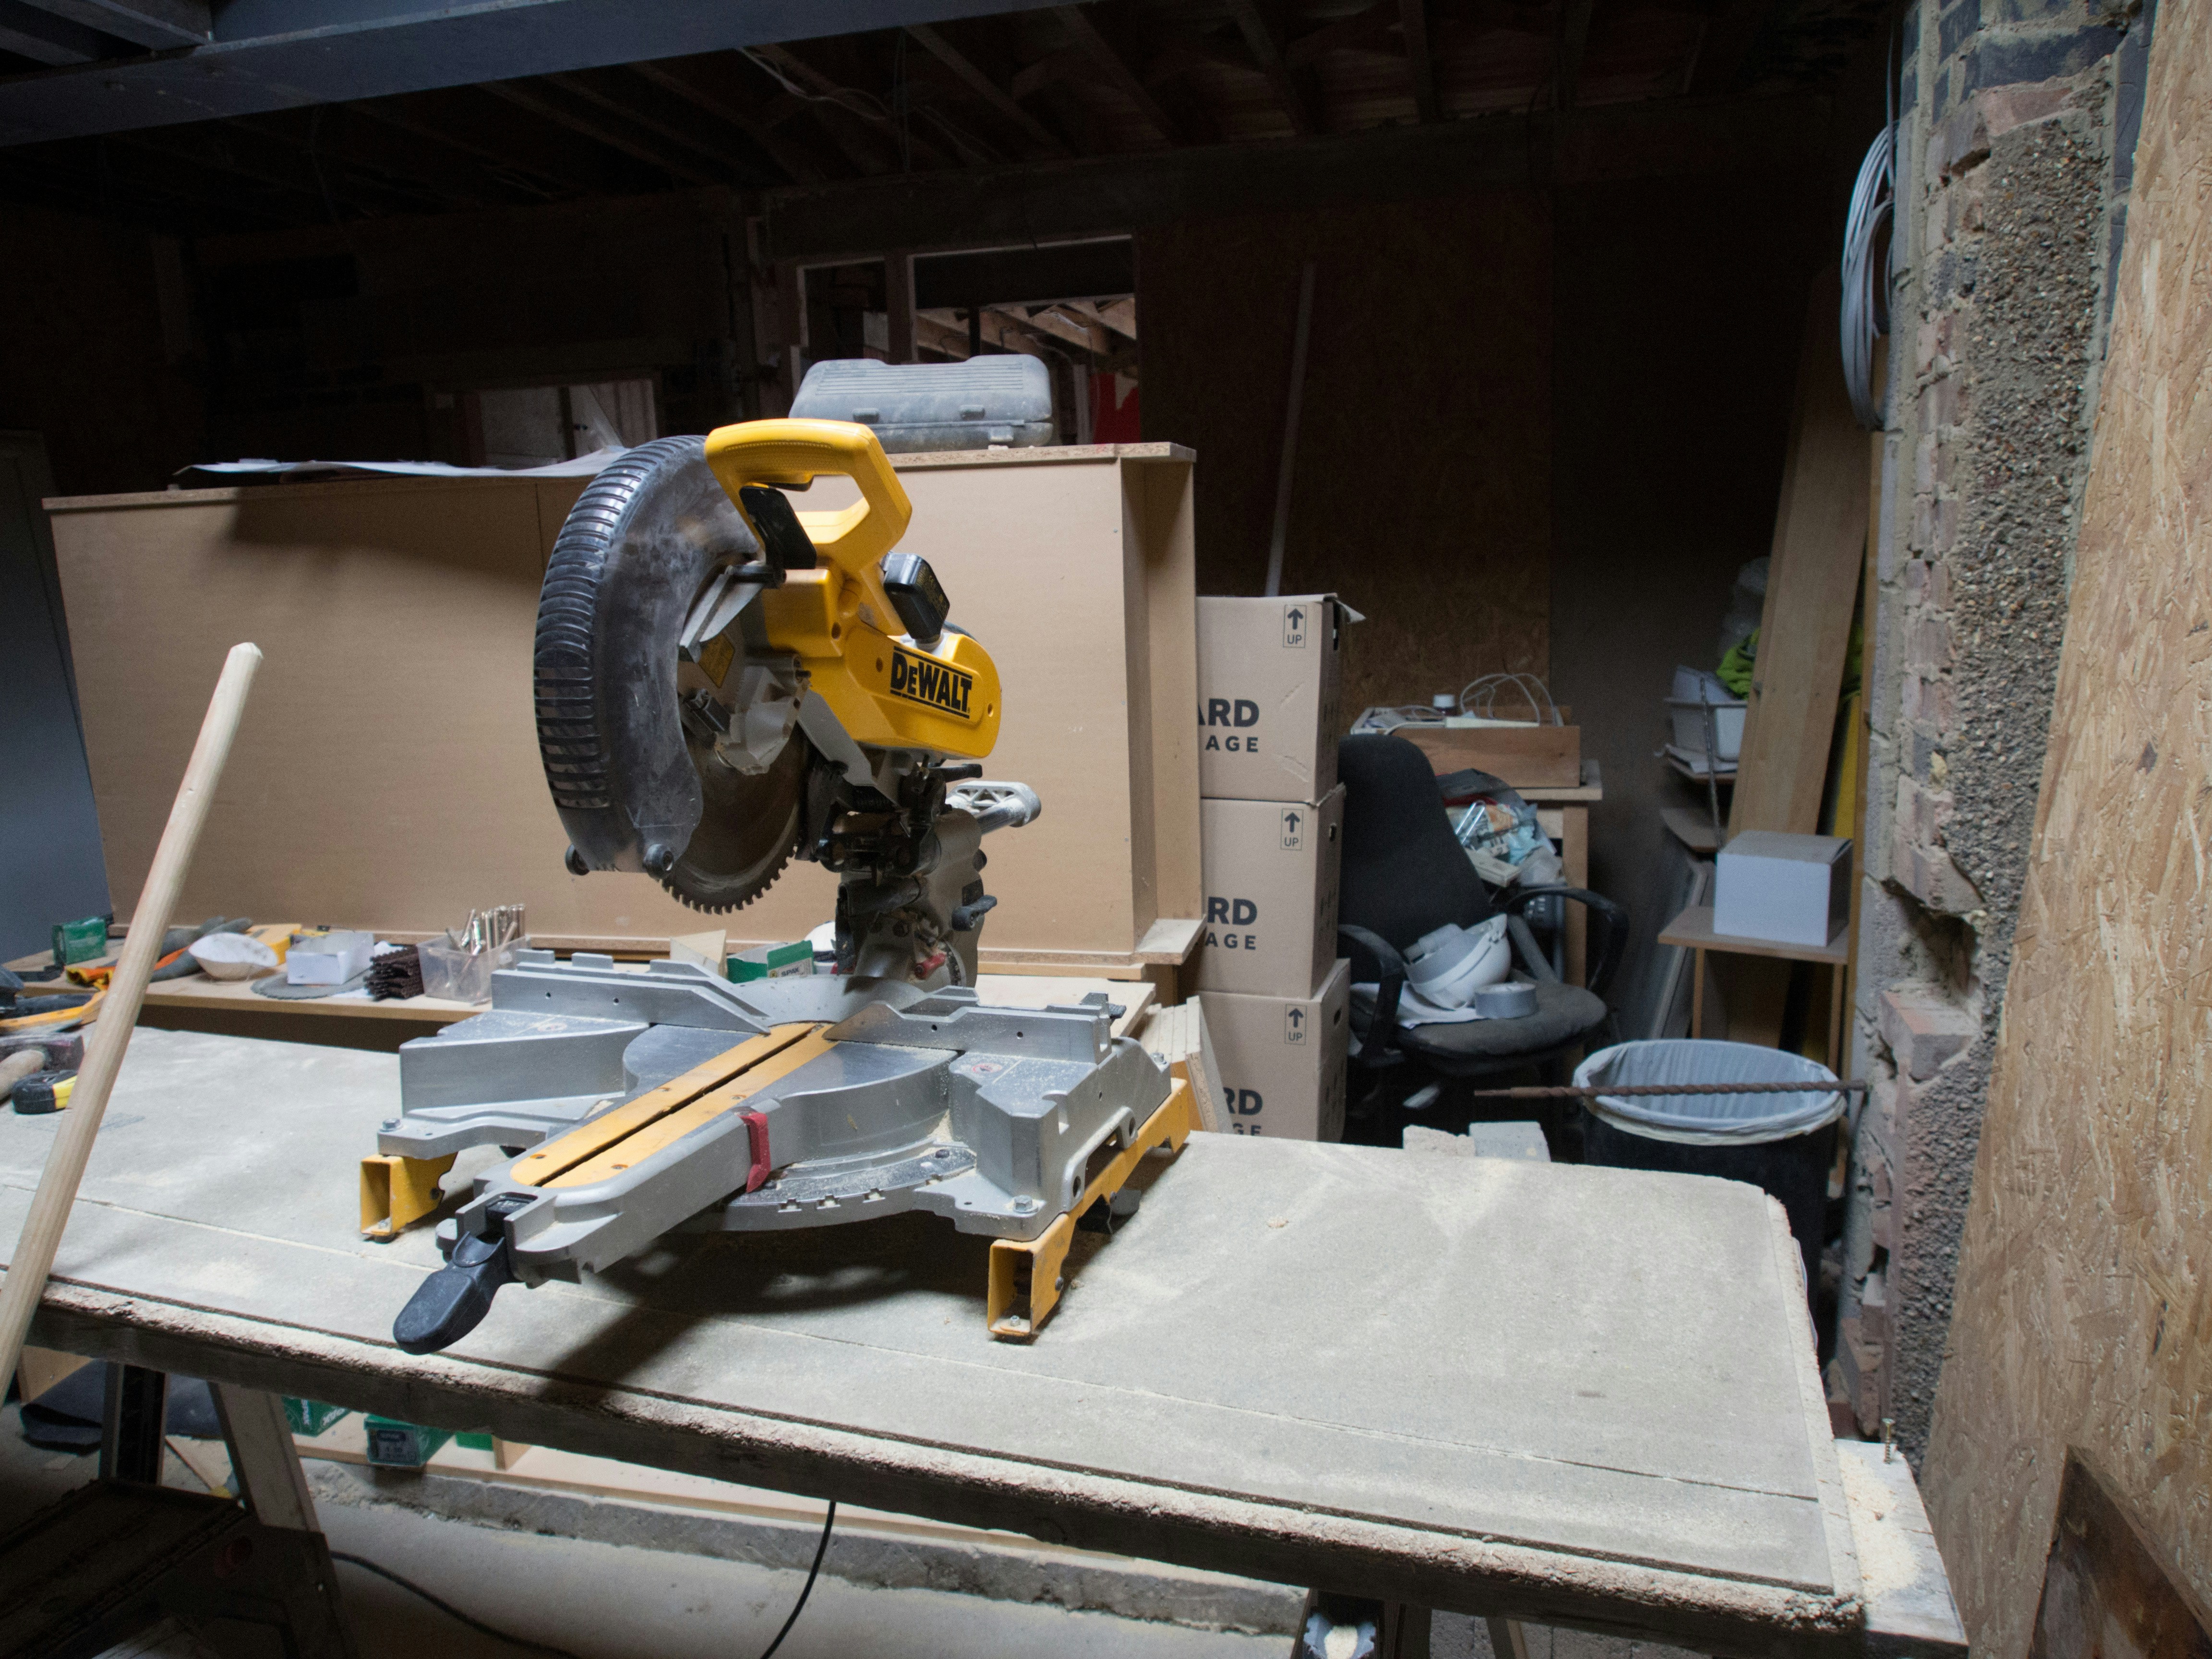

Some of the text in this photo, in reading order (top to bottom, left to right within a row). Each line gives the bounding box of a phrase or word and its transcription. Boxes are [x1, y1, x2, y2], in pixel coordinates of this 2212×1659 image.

[1287, 634, 1302, 645] UP
[890, 651, 972, 713] DEWALT
[1205, 735, 1259, 753] AGE
[1284, 837, 1299, 847] UP
[1207, 897, 1258, 926] RD
[1205, 932, 1256, 950] AGE
[1288, 1032, 1303, 1042] UP
